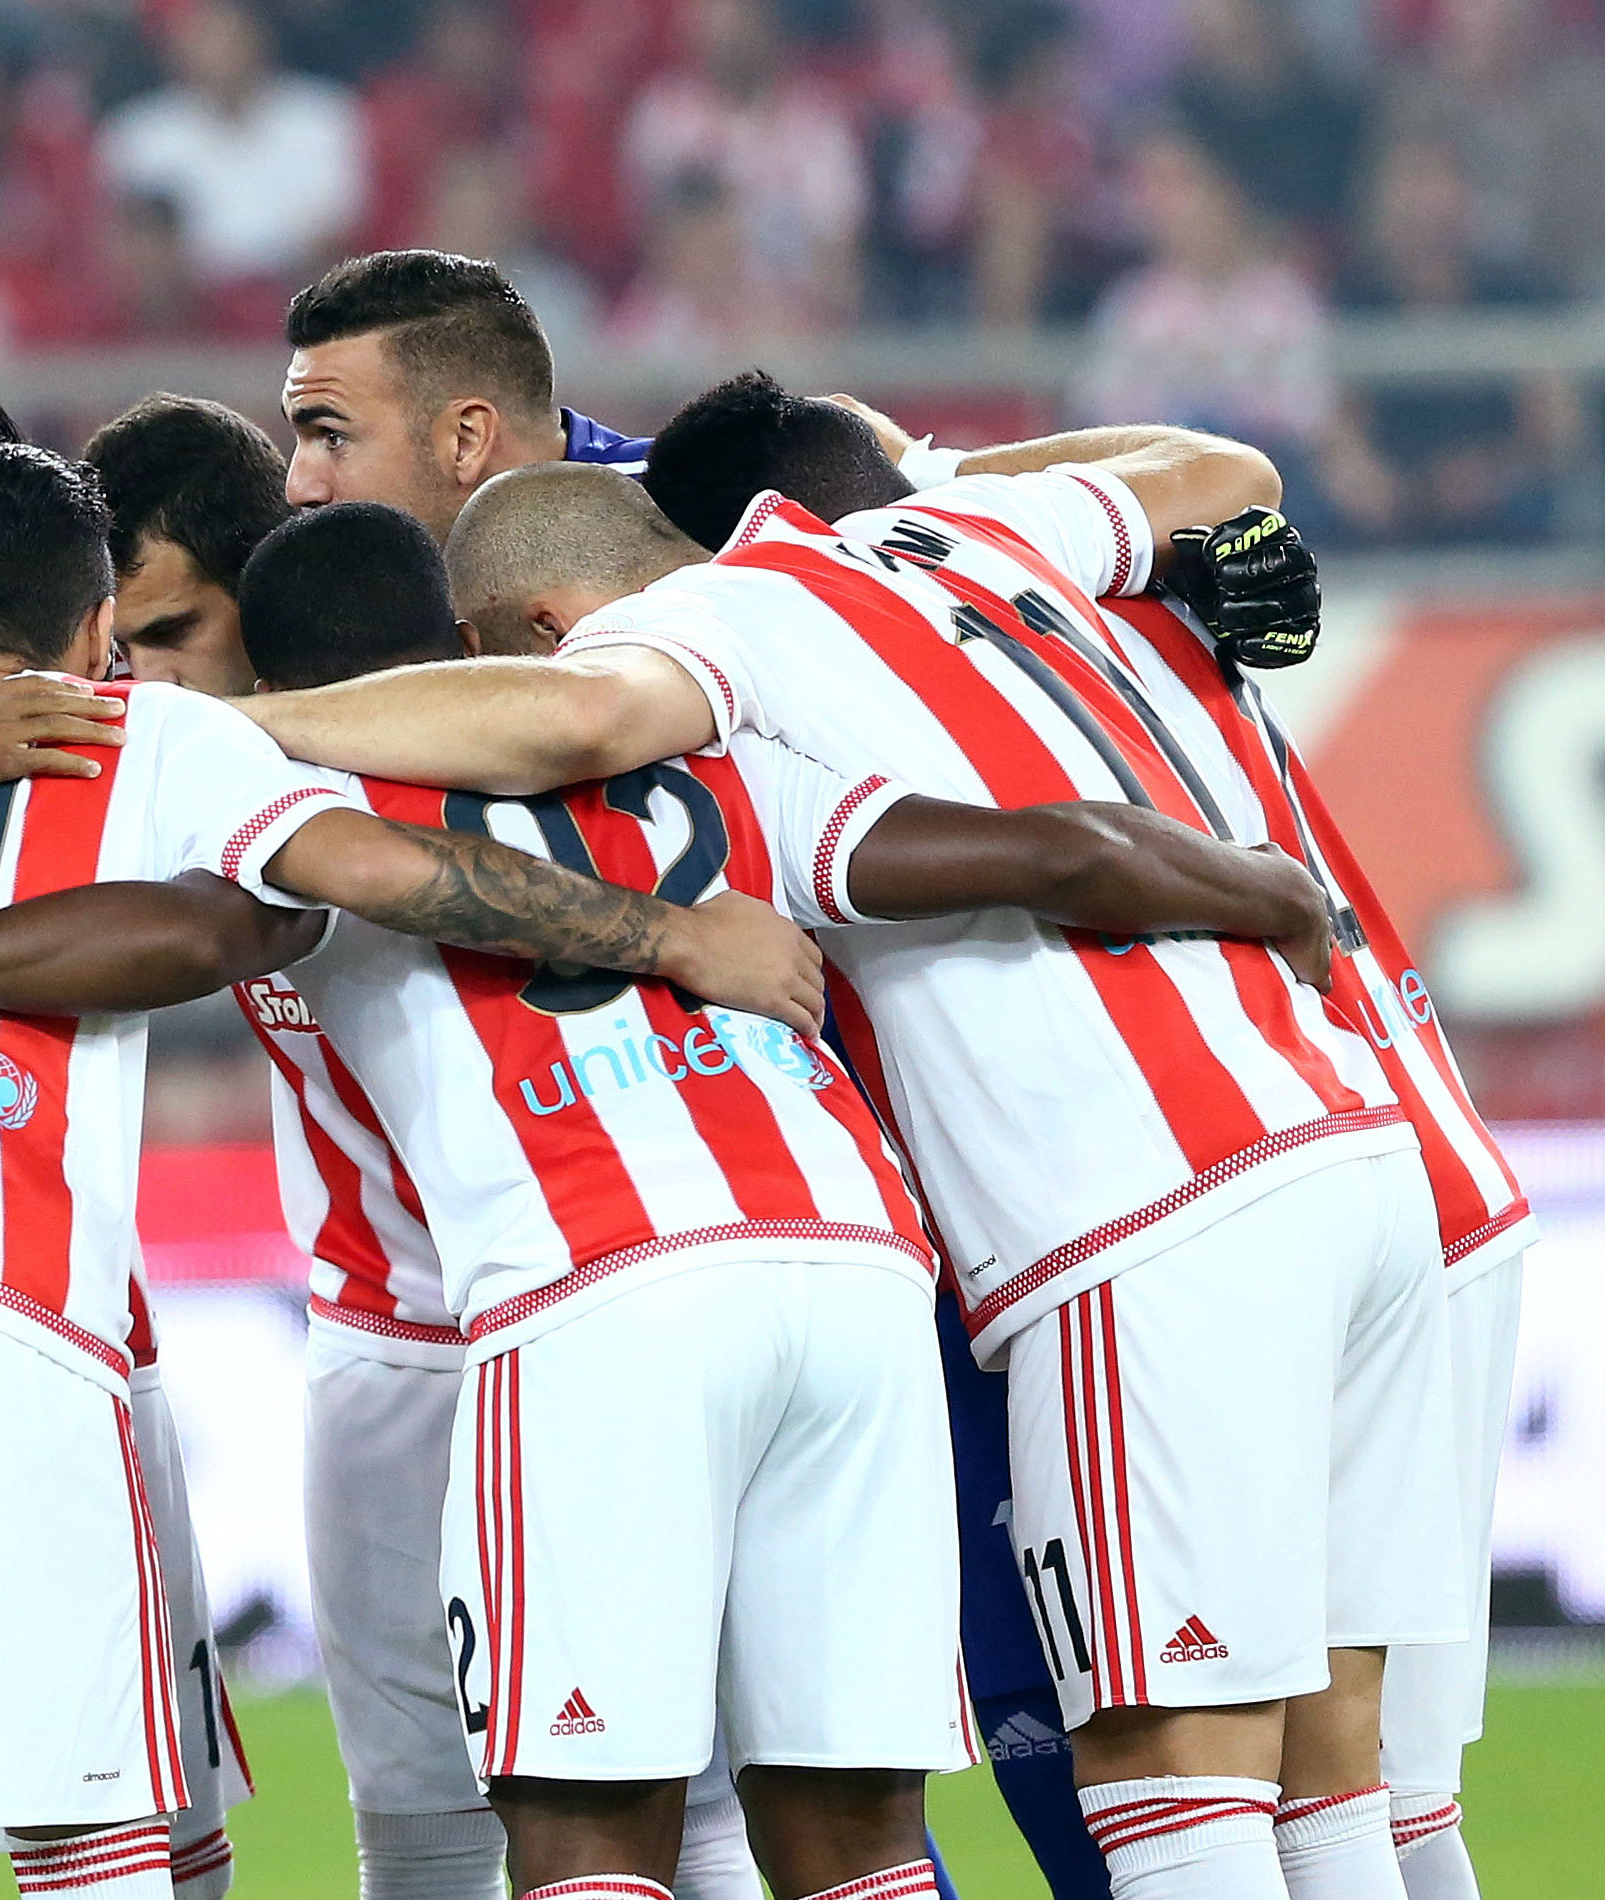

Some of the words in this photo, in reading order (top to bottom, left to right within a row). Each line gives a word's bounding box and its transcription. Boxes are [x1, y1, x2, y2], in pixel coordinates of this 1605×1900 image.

[1263, 629, 1314, 649] FENIX
[518, 1012, 745, 1117] unicef
[1022, 1536, 1093, 1682] 11
[448, 1596, 491, 1735] 2
[1159, 1643, 1230, 1664] adidas
[549, 1717, 606, 1737] adidas
